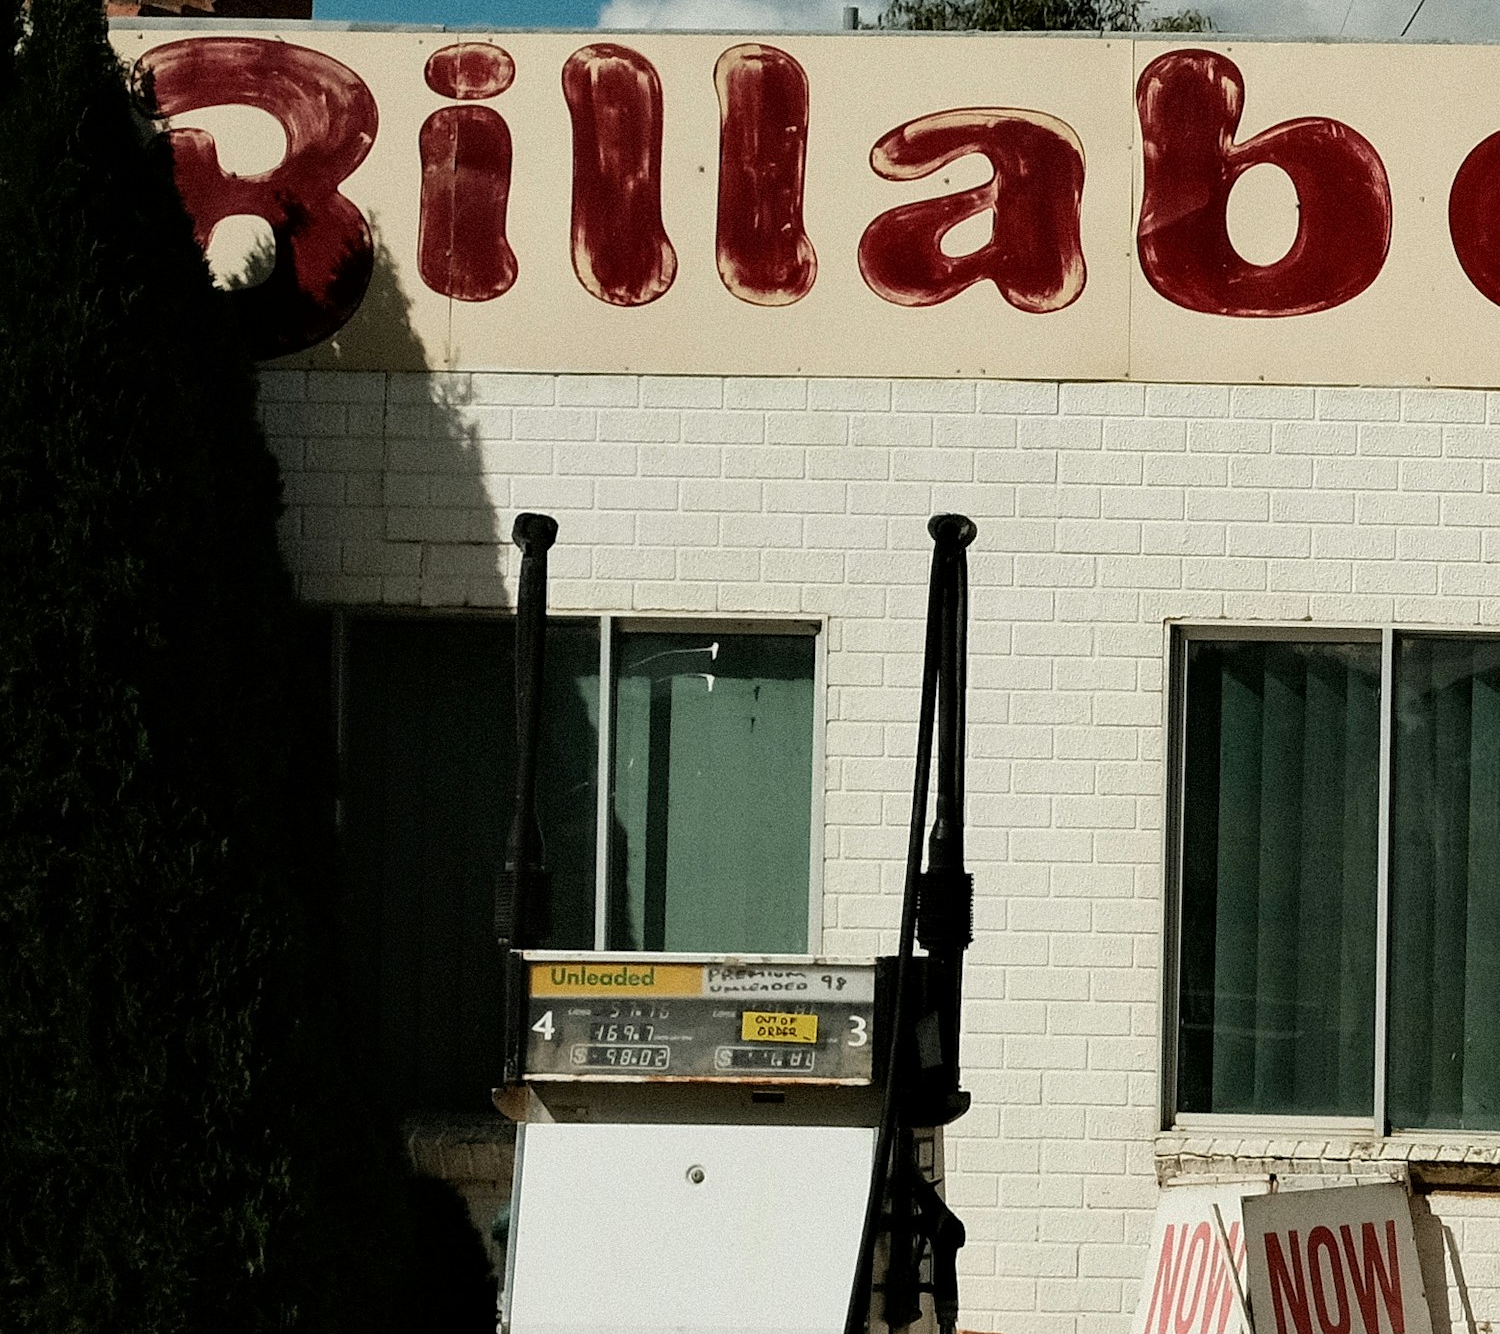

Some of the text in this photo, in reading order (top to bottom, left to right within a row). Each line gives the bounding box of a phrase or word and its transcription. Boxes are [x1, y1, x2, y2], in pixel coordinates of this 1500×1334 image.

[551, 967, 655, 987] Unleaded
[708, 967, 806, 983] PREMIUM
[821, 975, 847, 991] 98
[710, 981, 809, 993] UNLEADED
[531, 1010, 556, 1041] 4
[755, 1015, 797, 1025] OUT OF
[595, 1025, 654, 1042] 169.7
[757, 1027, 798, 1037] ORDER
[847, 1015, 868, 1047] 3
[606, 1049, 667, 1065] 98.02
